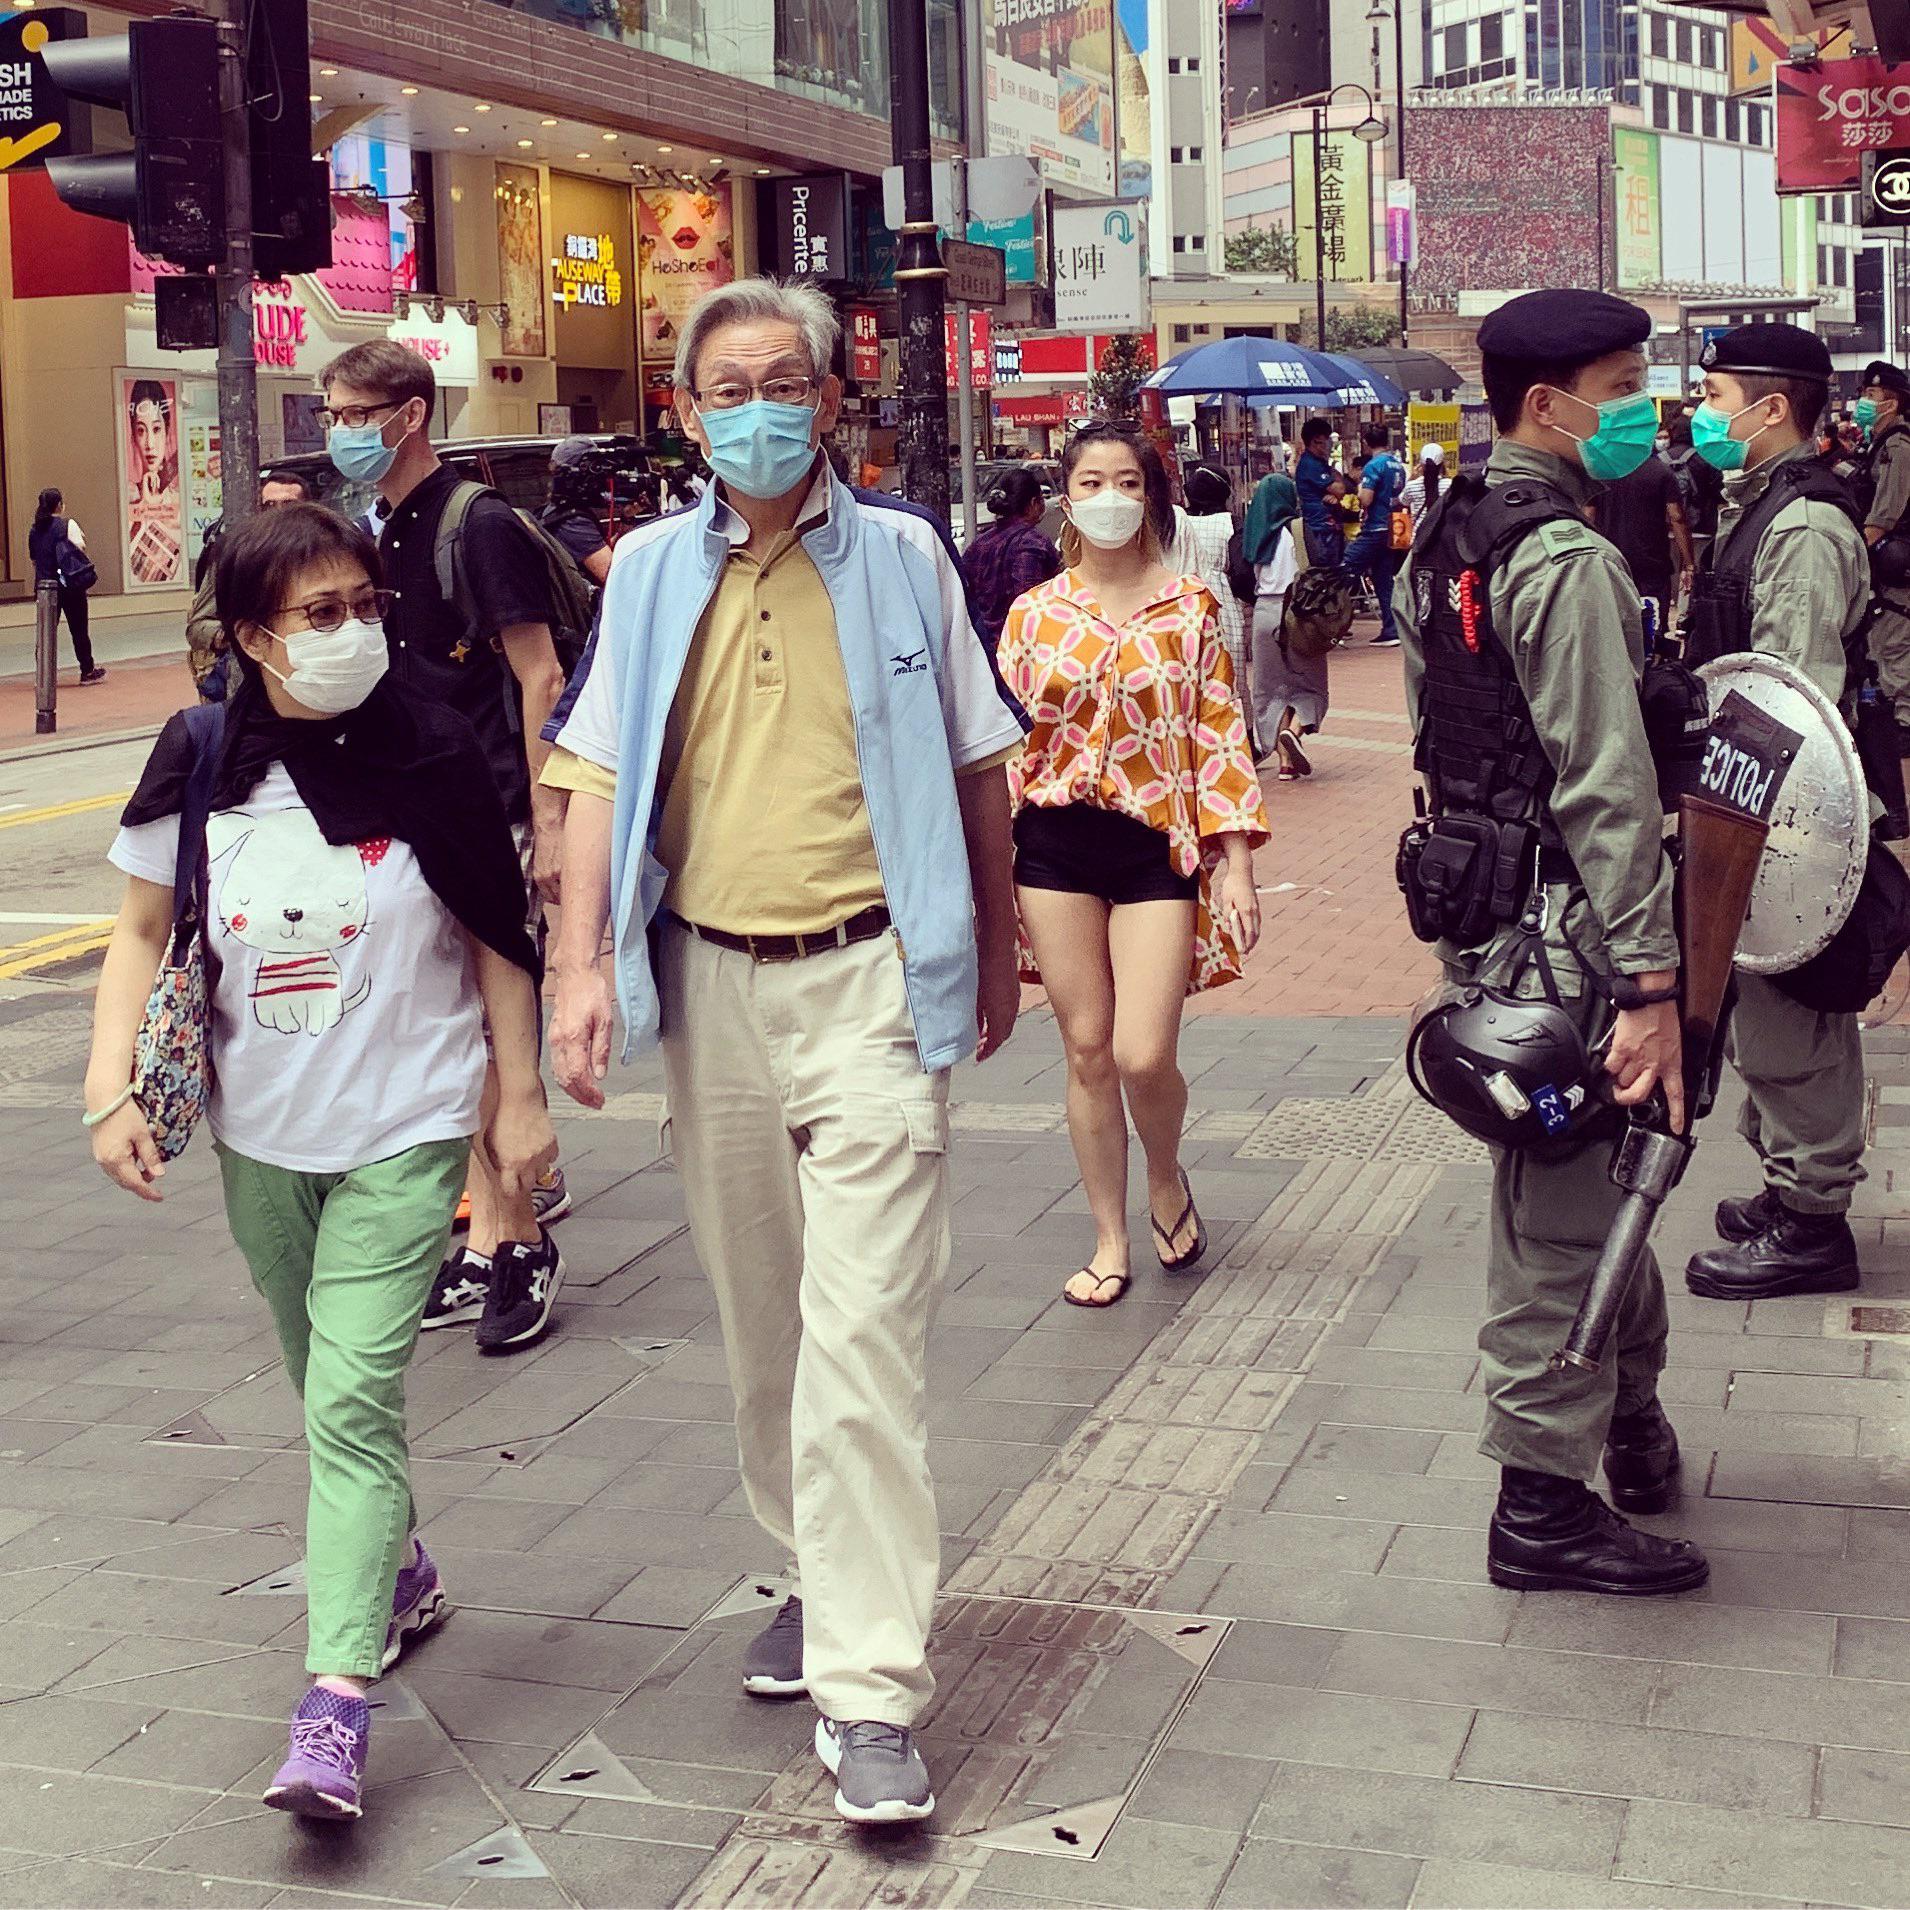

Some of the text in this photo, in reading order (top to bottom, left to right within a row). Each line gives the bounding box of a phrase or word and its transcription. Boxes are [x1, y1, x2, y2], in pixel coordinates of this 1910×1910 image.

[0, 89, 32, 104] ADE
[0, 106, 33, 121] TICS
[1841, 121, 1894, 147] 莎莎
[792, 187, 809, 273] Pricerite
[551, 257, 605, 284] AUSEWAY
[563, 281, 606, 312] PLACE
[254, 303, 308, 343] UDE
[254, 341, 297, 366] OUSE
[1700, 735, 1775, 816] POLICE
